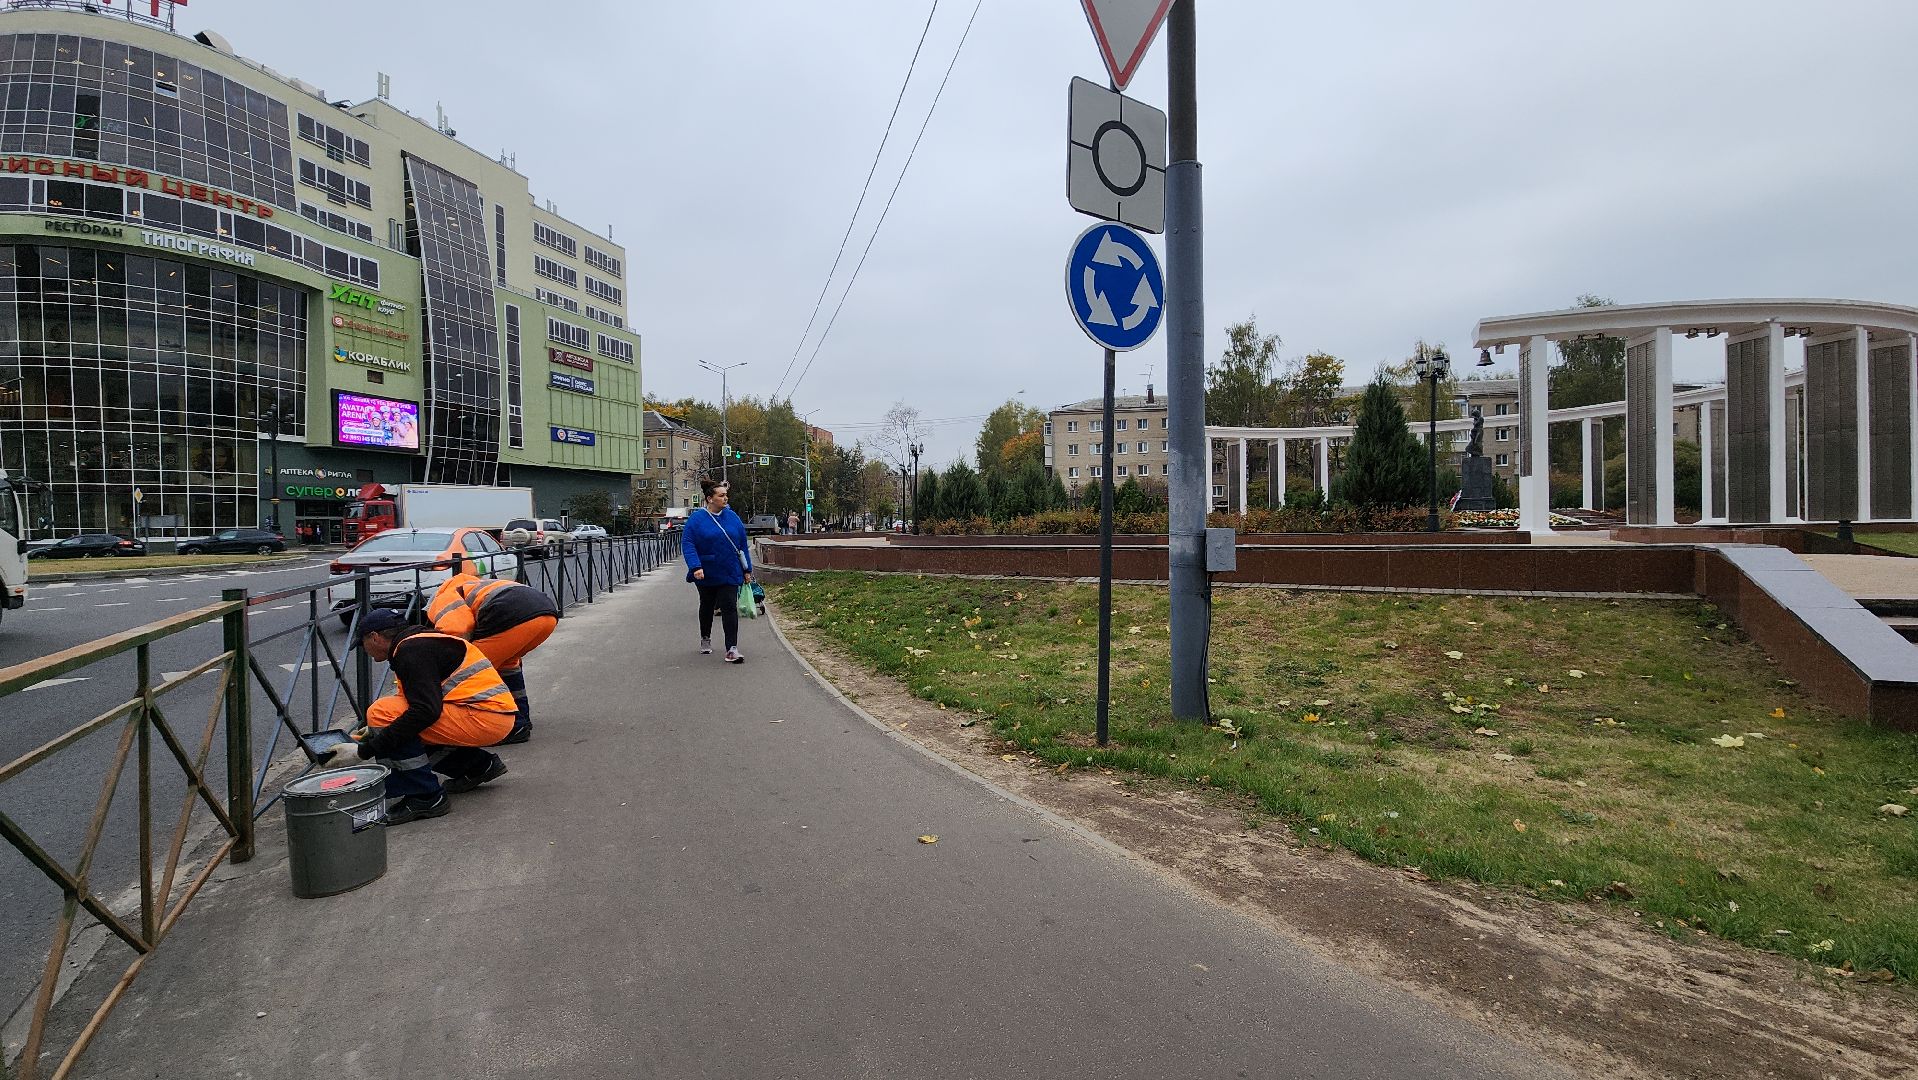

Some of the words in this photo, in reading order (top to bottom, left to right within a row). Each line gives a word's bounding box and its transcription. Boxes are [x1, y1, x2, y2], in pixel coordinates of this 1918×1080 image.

[0, 155, 149, 189] ИСНЫЙ
[161, 177, 274, 219] ЦЕНТР
[44, 220, 123, 238] РЕСТОРАН
[141, 230, 256, 267] ТИПОГРАФИЯ
[328, 282, 377, 309] XFIT
[348, 350, 411, 372] КОРАБЛИК
[341, 411, 367, 419] ARENA
[280, 468, 314, 476] АПТЕКА
[327, 470, 352, 479] РИГЛА
[286, 485, 334, 498] супер
[346, 488, 362, 497] ле
